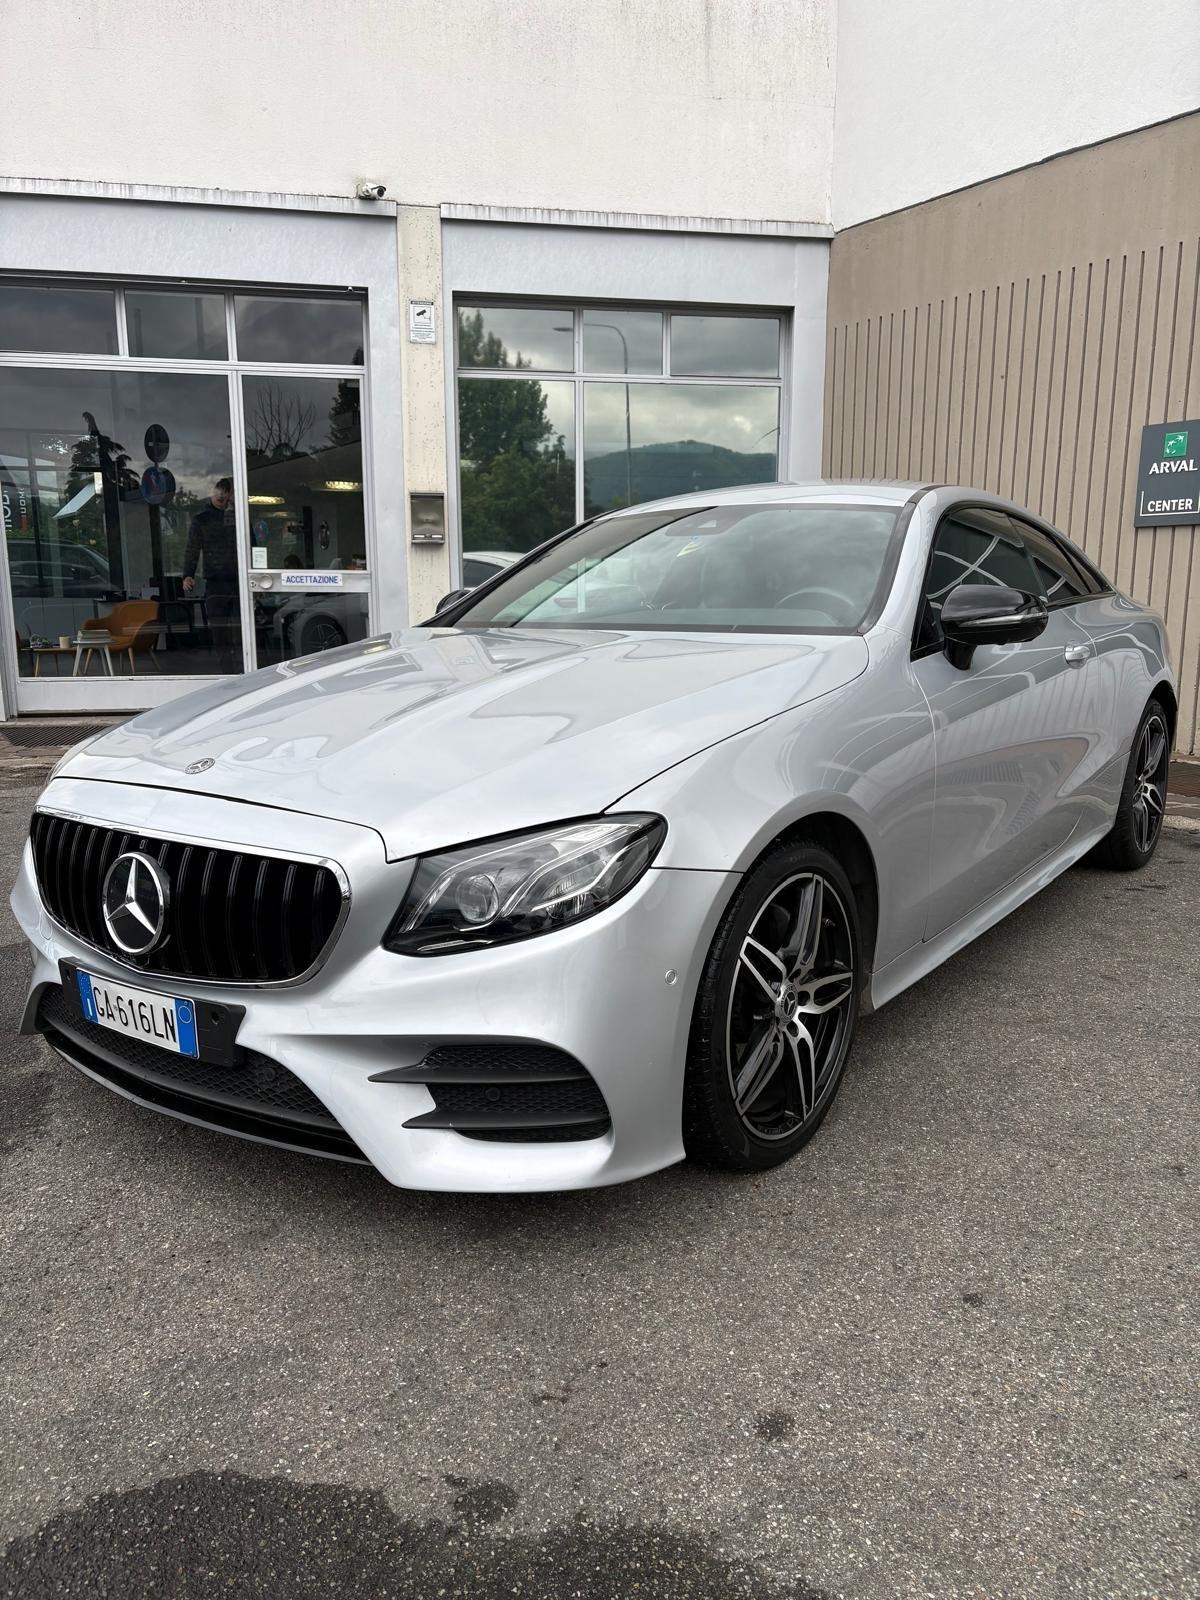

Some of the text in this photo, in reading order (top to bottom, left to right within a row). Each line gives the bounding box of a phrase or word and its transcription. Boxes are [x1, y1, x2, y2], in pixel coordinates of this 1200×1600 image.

[1148, 459, 1198, 475] ARVAL
[1147, 498, 1193, 512] CENTER
[286, 575, 339, 584] ACCETTAZIONE
